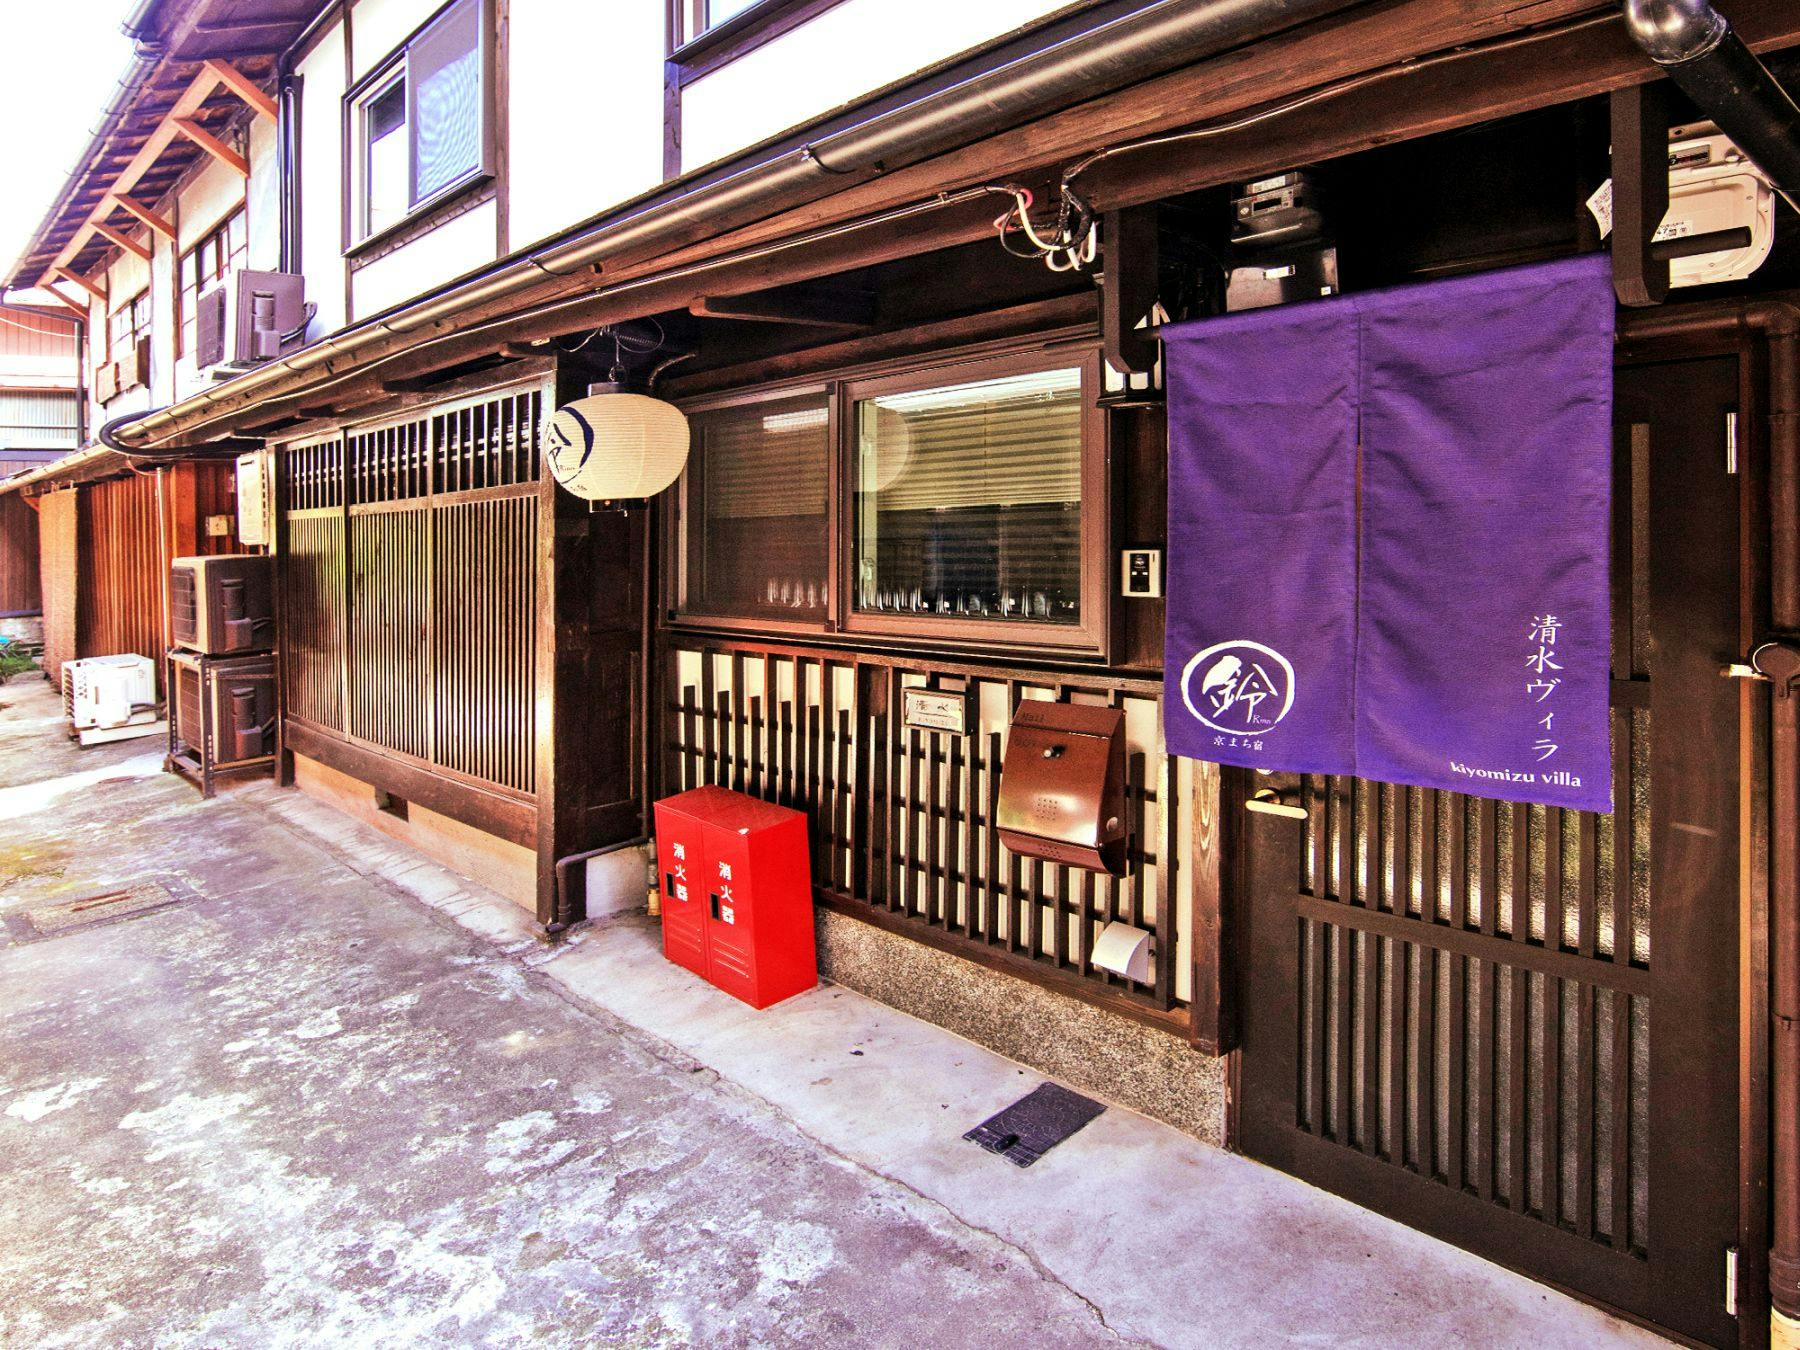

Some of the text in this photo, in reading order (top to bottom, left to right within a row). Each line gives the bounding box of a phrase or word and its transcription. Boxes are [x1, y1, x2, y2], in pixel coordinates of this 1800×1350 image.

[1524, 614, 1564, 762] 清水ヴィラ
[1450, 761, 1581, 787] kiyomizu villa
[673, 842, 688, 902] 消火器
[718, 861, 735, 925] 消火器
